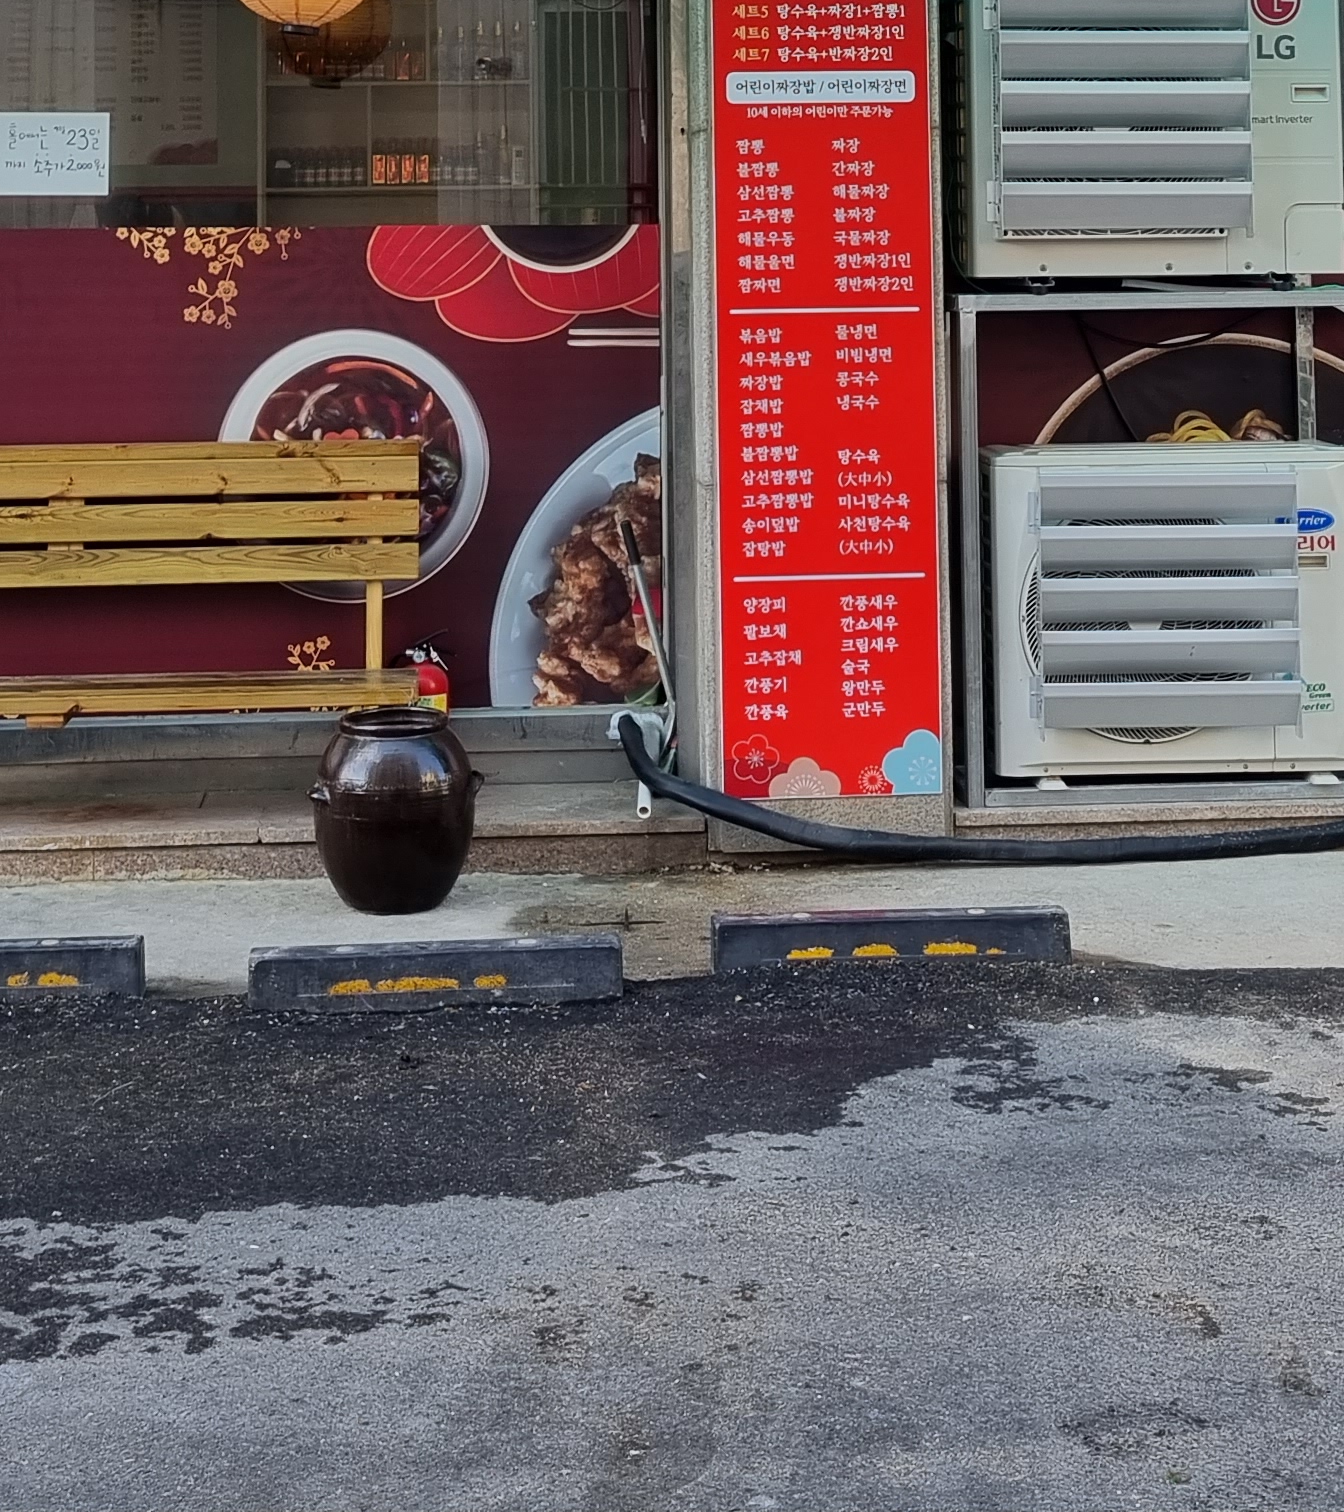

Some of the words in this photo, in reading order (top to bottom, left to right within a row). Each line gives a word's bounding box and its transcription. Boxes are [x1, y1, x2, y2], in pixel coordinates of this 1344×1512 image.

[733, 4, 768, 18] 세트5
[777, 3, 904, 19] 탕수육+짜장1+짬뽕1
[733, 26, 769, 40] 세트6
[777, 25, 904, 40] 탕수육+쟁반짜장1인
[733, 48, 769, 61] 세트7
[1257, 34, 1296, 60] LG
[736, 80, 814, 94] 어린이짜장밥
[828, 80, 905, 93] 어린이짜장면
[748, 106, 768, 118] 10세
[771, 106, 802, 118] 이하의
[805, 105, 848, 117] 어린이만
[850, 105, 893, 117] 주문가능
[1251, 115, 1274, 124] mart
[736, 139, 764, 154] 짬뽕
[832, 138, 860, 153] 짜장
[737, 162, 779, 177] 불짬뽕
[833, 161, 875, 176] 간짜장
[737, 185, 794, 200] 삼선짬뽕
[833, 184, 889, 199] 해물짜장
[738, 208, 794, 223] 고추짬뽕
[833, 207, 876, 222] 불짜장
[738, 232, 795, 247] 해물우동
[834, 230, 890, 245] 국물짜장
[738, 254, 794, 270] 해물울면
[835, 253, 910, 269] 쟁반짜장1인
[739, 278, 780, 293] 짬짜면
[835, 276, 913, 292] 쟁반짜장2인
[740, 328, 782, 343] 볶음밥
[836, 324, 877, 340] 물냉면
[740, 351, 811, 366] 새우볶음밥
[836, 347, 891, 363] 비빔냉면
[740, 375, 783, 390] 짜장밥
[836, 371, 879, 387] 콩국수
[741, 398, 783, 414] 잡채밥
[837, 395, 879, 410] 냉국수
[741, 422, 783, 438] 짬뽕밥
[741, 445, 798, 462] 불짬뽕밥
[838, 449, 880, 464] 탕수육
[741, 469, 813, 485] 삼선짬뽕밥
[742, 493, 814, 509] 고추짬뽕밥
[839, 493, 910, 509] 미니탕수육
[742, 517, 800, 534] 송이덮밥
[839, 516, 910, 532] 사천탕수육
[743, 541, 786, 557] 잡탕밥
[1297, 534, 1336, 552] 리어
[744, 597, 785, 613] 양장피
[840, 595, 897, 611] 깐풍새우
[744, 624, 786, 640] 팔보채
[841, 616, 898, 632] 깐쇼새우
[841, 637, 898, 653] 크림새우
[744, 650, 801, 666] 고추잡채
[842, 659, 870, 675] 술국
[745, 677, 786, 693] 깐풍기
[842, 680, 885, 696] 왕만두
[1306, 683, 1326, 692] ECO
[745, 704, 788, 720] 깐풍육
[842, 701, 885, 717] 군만두
